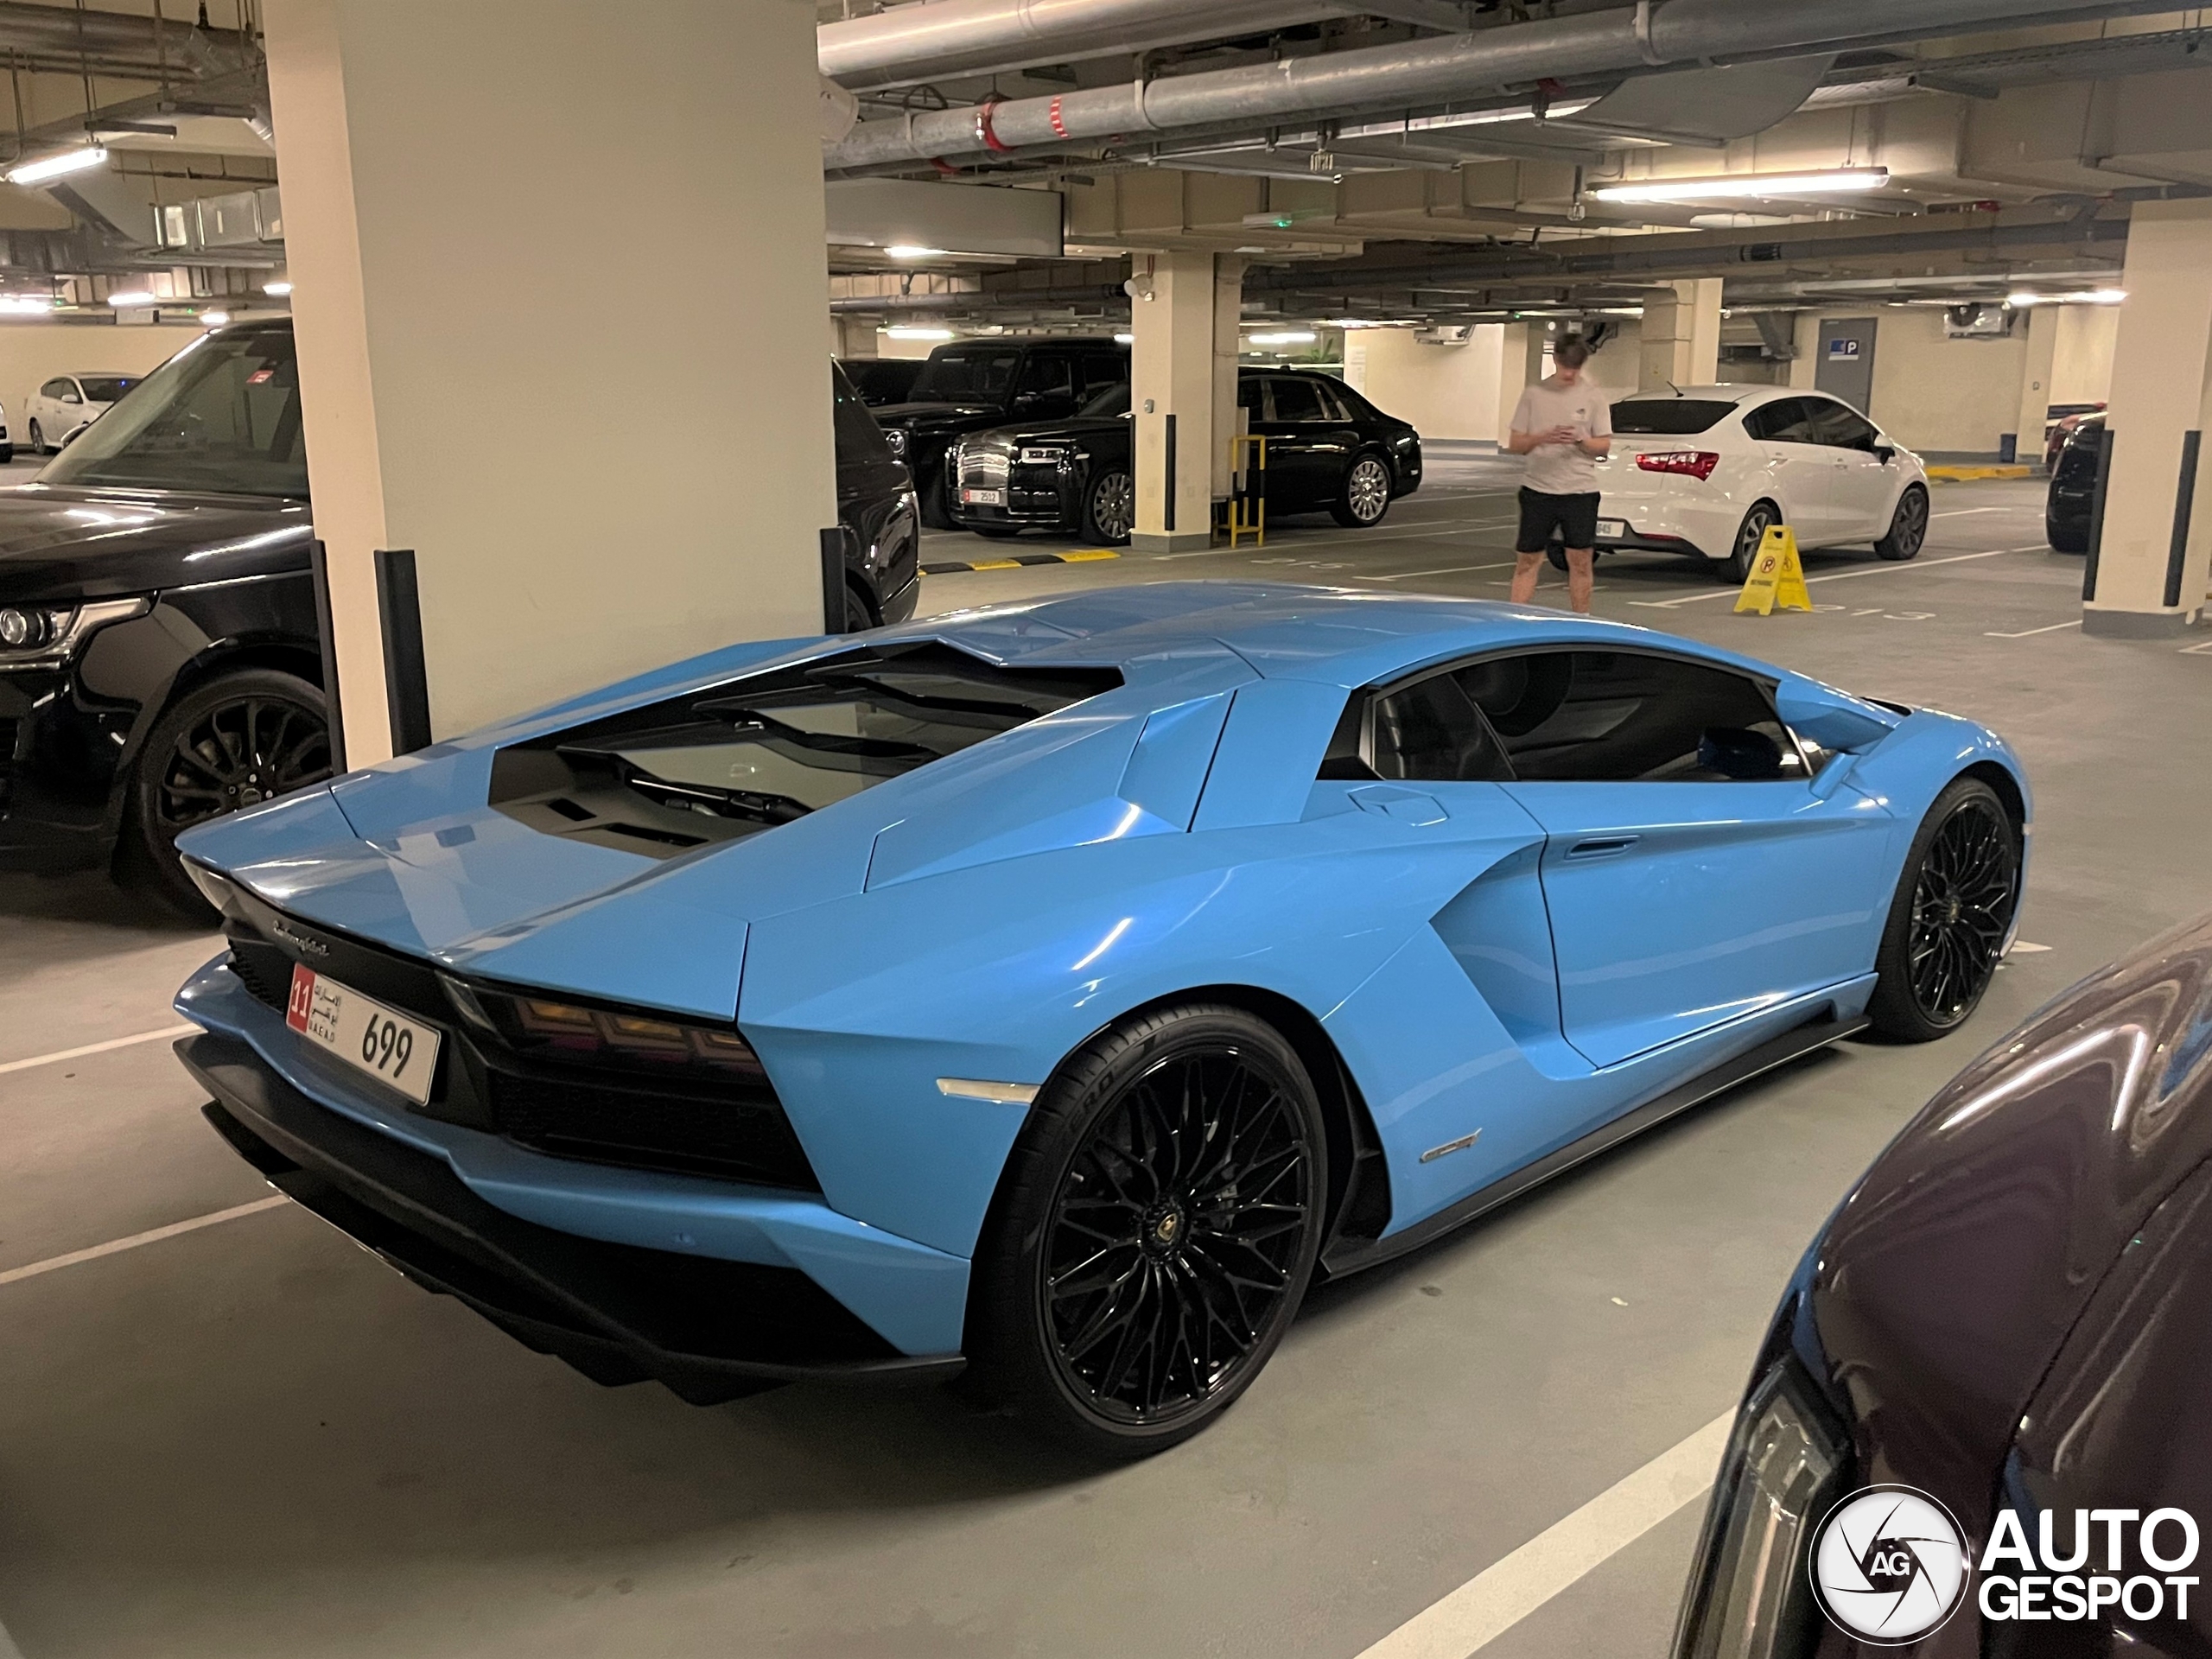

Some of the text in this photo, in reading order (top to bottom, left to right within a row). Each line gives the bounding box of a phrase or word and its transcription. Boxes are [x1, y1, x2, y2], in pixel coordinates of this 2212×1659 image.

[1847, 341, 1857, 353] P
[291, 980, 310, 1017] 11
[362, 1013, 413, 1078] 699
